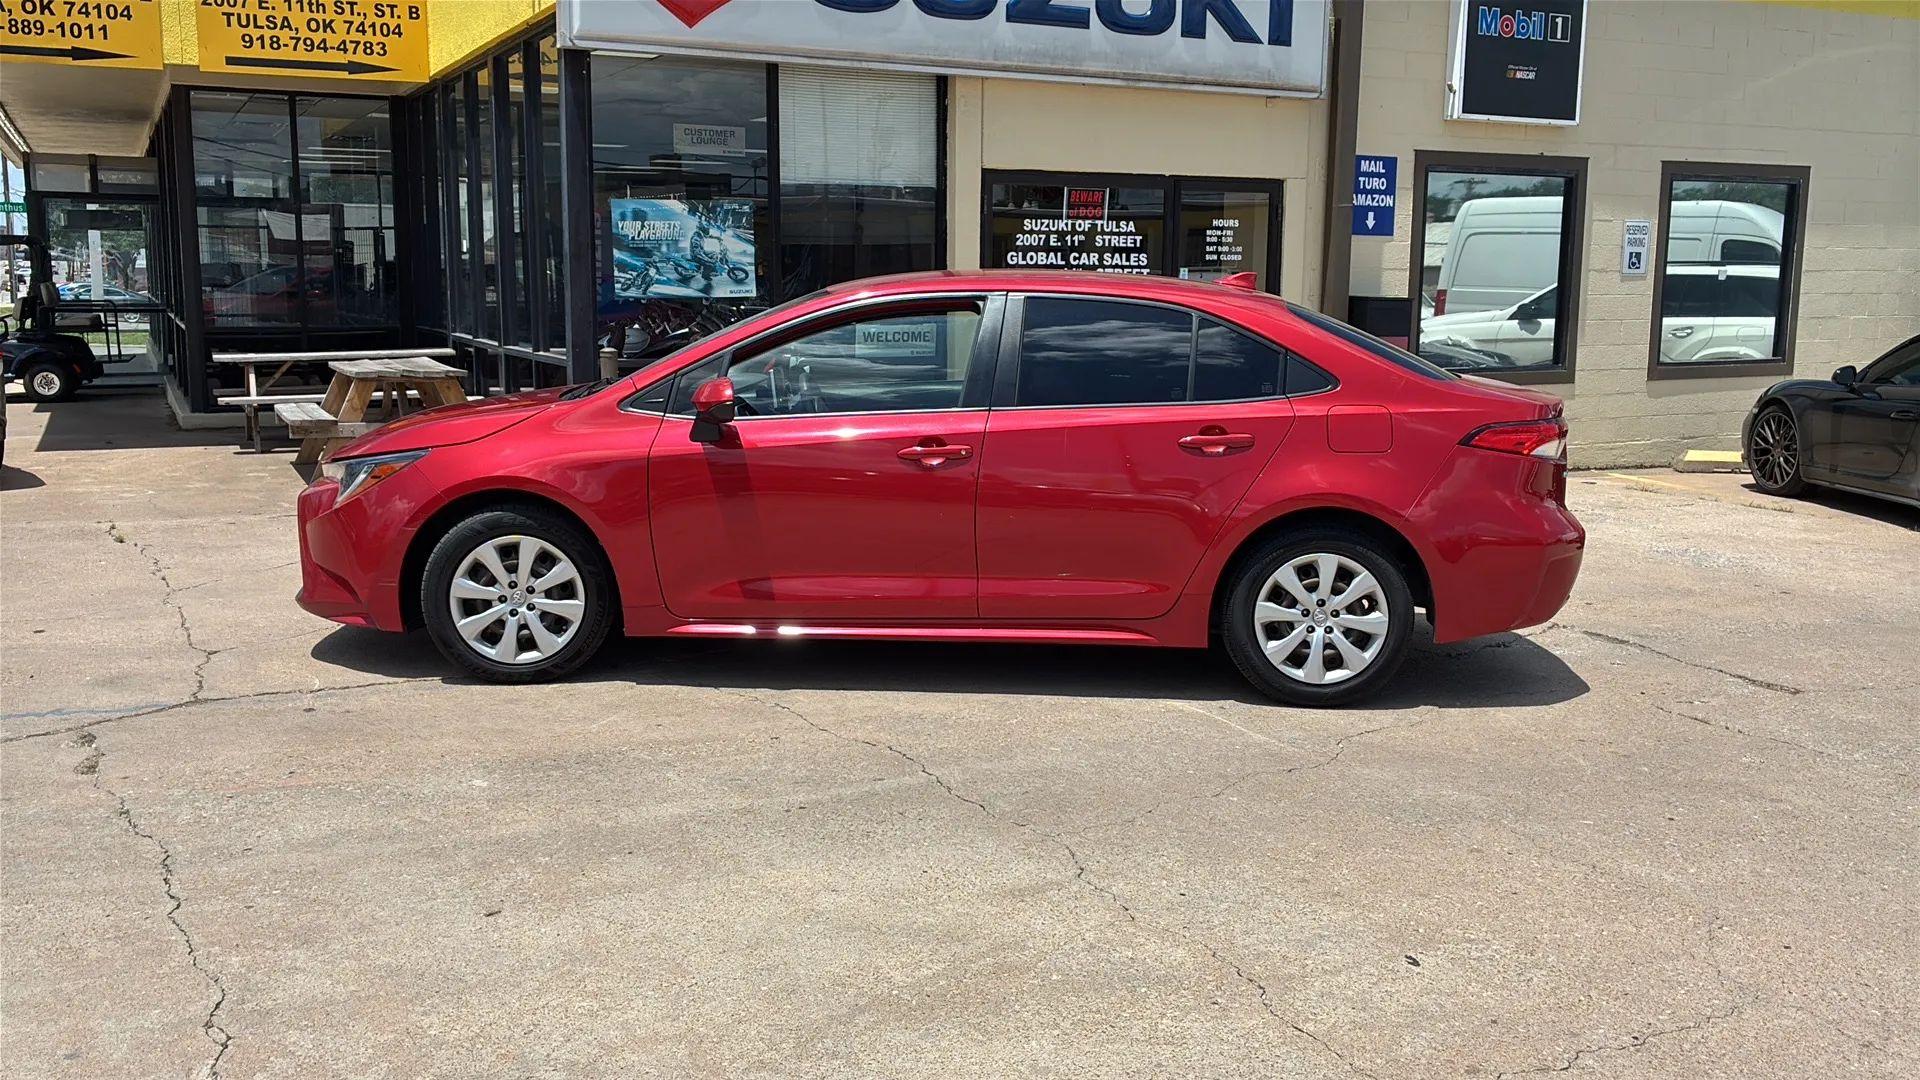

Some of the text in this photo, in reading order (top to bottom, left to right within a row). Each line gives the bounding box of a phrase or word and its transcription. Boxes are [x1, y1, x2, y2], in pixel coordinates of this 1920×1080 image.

[20, 0, 56, 16] OK
[63, 1, 133, 21] 74104
[283, 0, 326, 15] 11th
[374, 3, 401, 19] ST.
[408, 5, 421, 21] B
[221, 12, 403, 38] TULSA, OK 74104
[1478, 6, 1545, 40] Mobil
[240, 33, 388, 57] 918-794-4783
[684, 128, 735, 138] CUSTOMER
[692, 137, 728, 145] LOUNGE
[1361, 160, 1385, 172] MAIL
[1359, 177, 1387, 190] TURO
[1071, 190, 1104, 203] BEWARE
[1353, 194, 1394, 207] AMAZON
[1080, 207, 1102, 217] DOG
[618, 221, 681, 232] YOUR STREETS
[1023, 219, 1136, 233] SUZUKI OF TULSA
[1213, 219, 1239, 227] HOURS
[1627, 225, 1648, 236] RESERVED
[1016, 234, 1143, 248] 2007 E. 11th STREET
[1627, 237, 1646, 248] PARKING
[1007, 252, 1148, 267] GLOBAL CAR SALES
[863, 331, 932, 343] WELCOME
